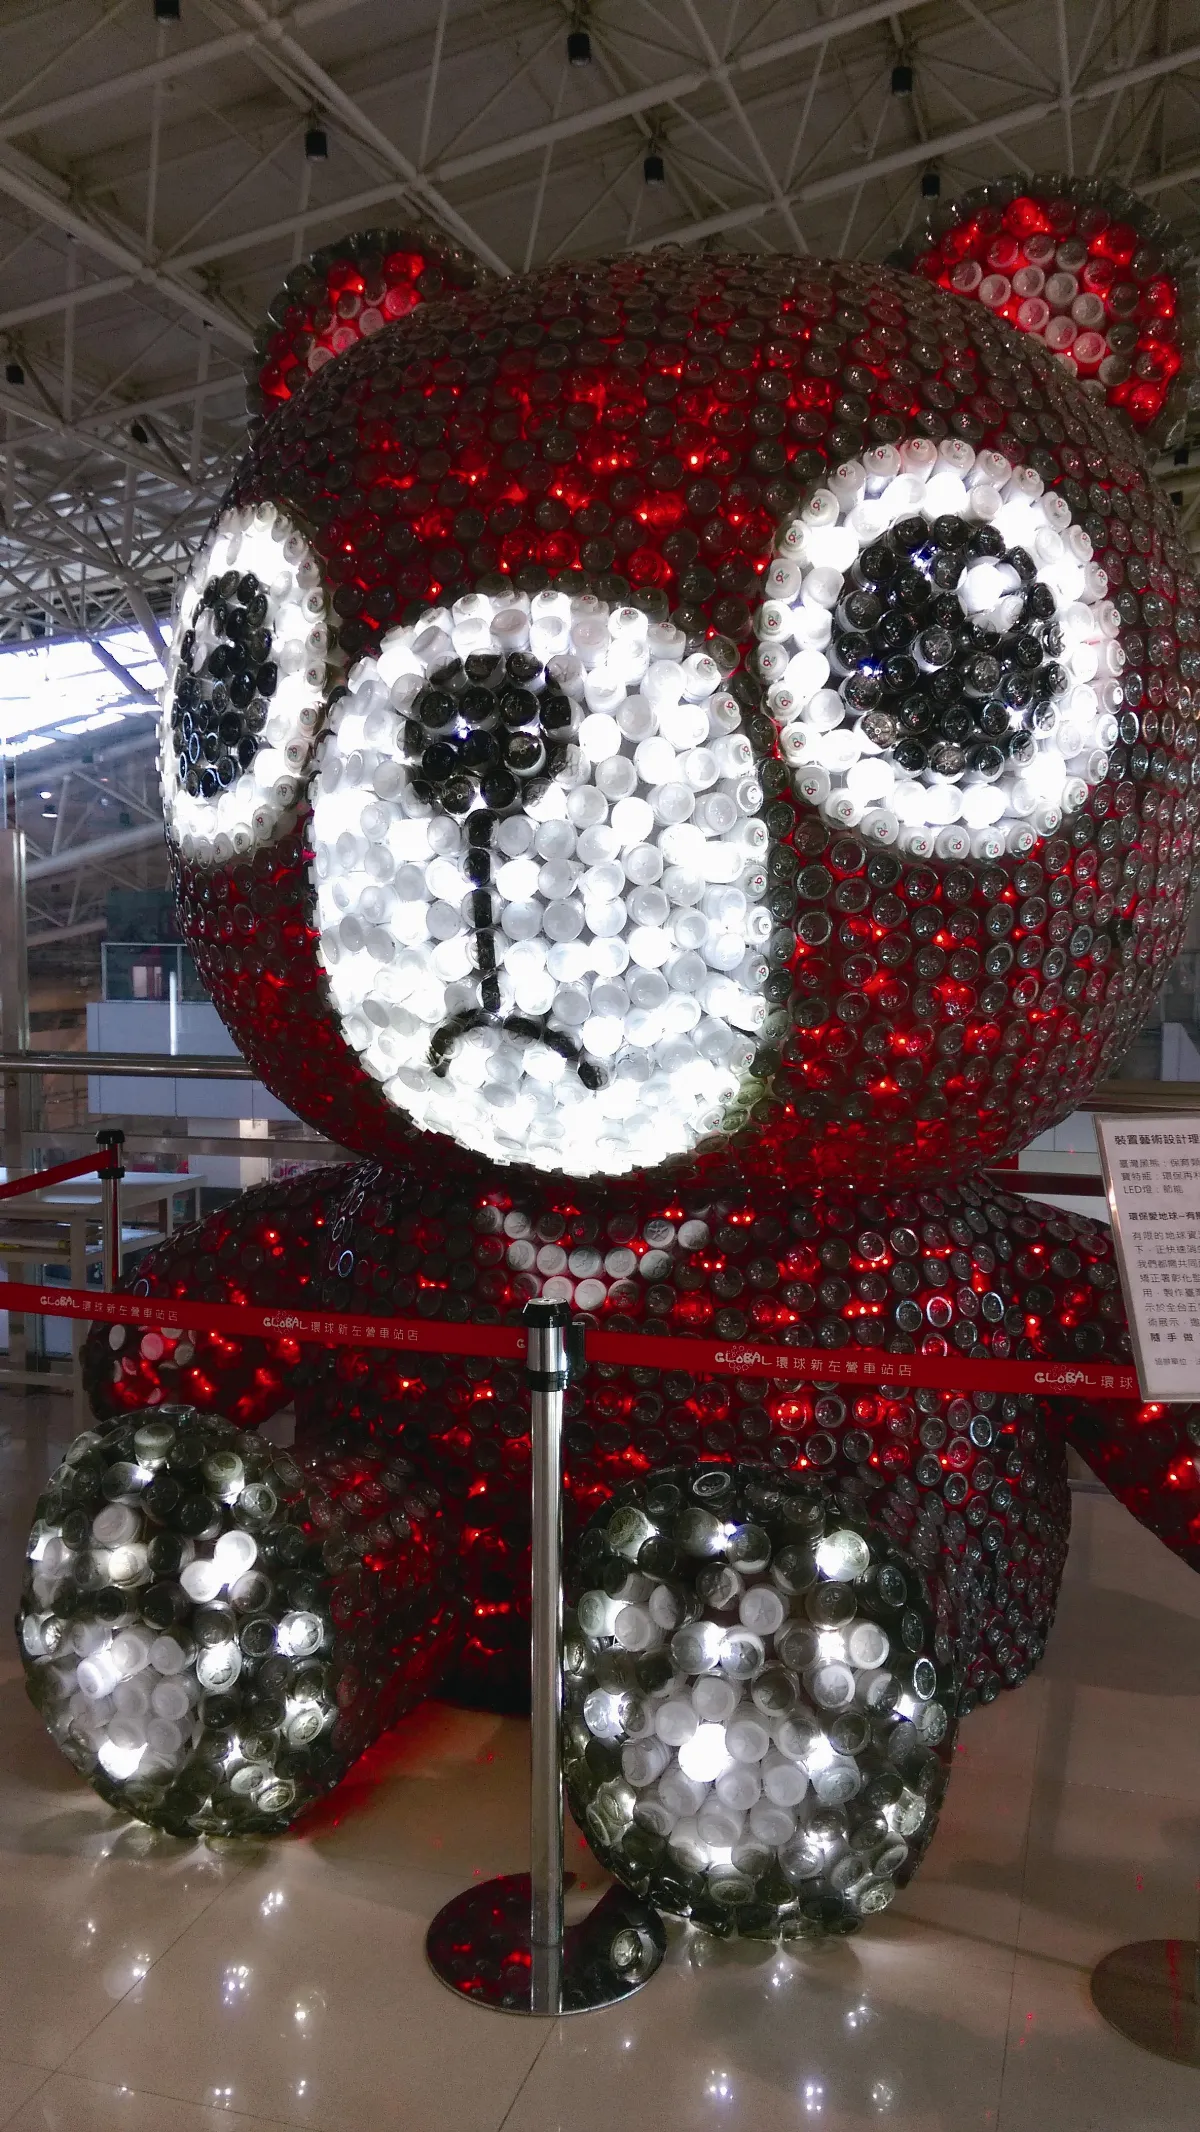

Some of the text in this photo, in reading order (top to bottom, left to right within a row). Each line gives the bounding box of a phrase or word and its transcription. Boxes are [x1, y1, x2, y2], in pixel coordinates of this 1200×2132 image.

[82, 1300, 178, 1321] 環球新左營車站店
[310, 1321, 419, 1341] 環球新左營車站店
[775, 1356, 912, 1377] 環球新左營車站店
